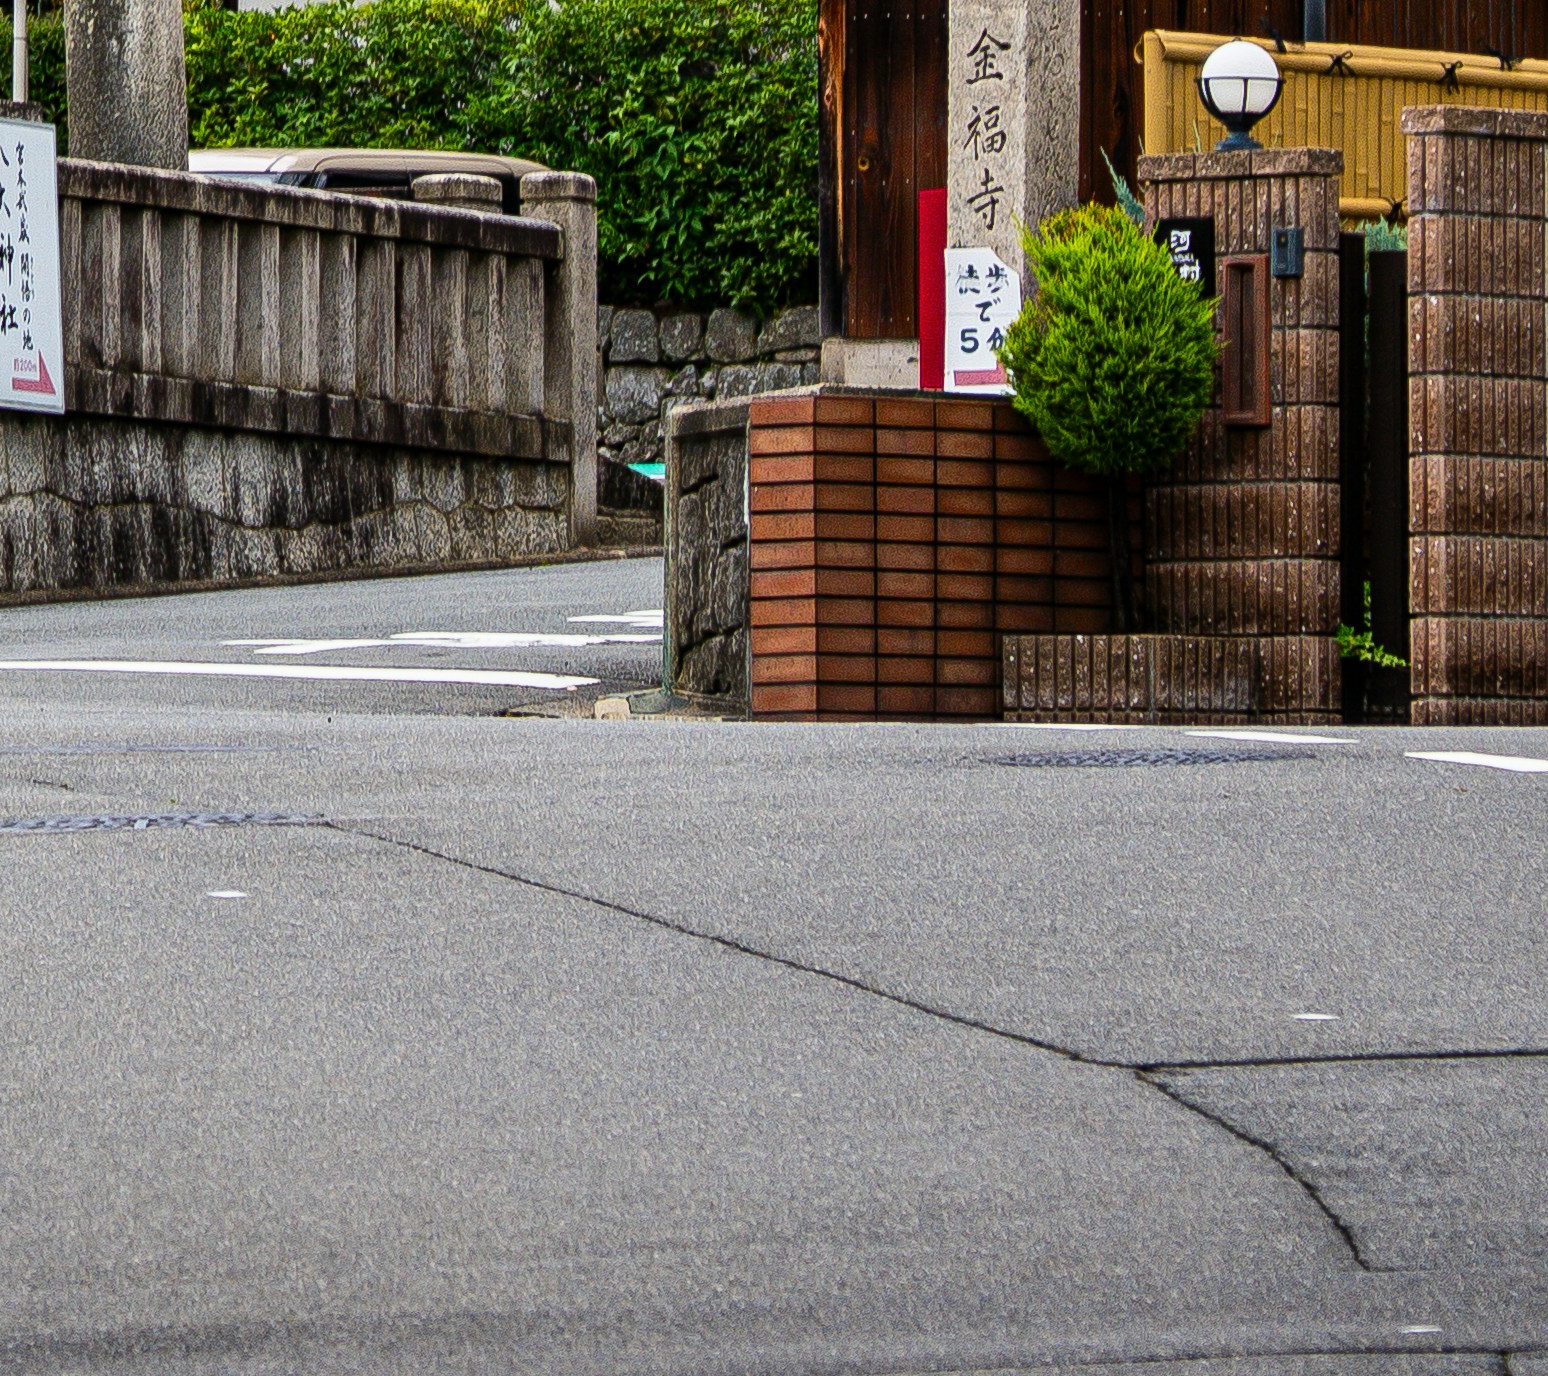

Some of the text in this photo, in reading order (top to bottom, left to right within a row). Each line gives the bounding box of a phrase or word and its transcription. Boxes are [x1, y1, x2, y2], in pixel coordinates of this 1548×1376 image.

[963, 27, 1012, 231] 金福寺
[955, 263, 1010, 294] 徒歩
[975, 297, 1001, 322] で
[960, 326, 1004, 353] 5分
